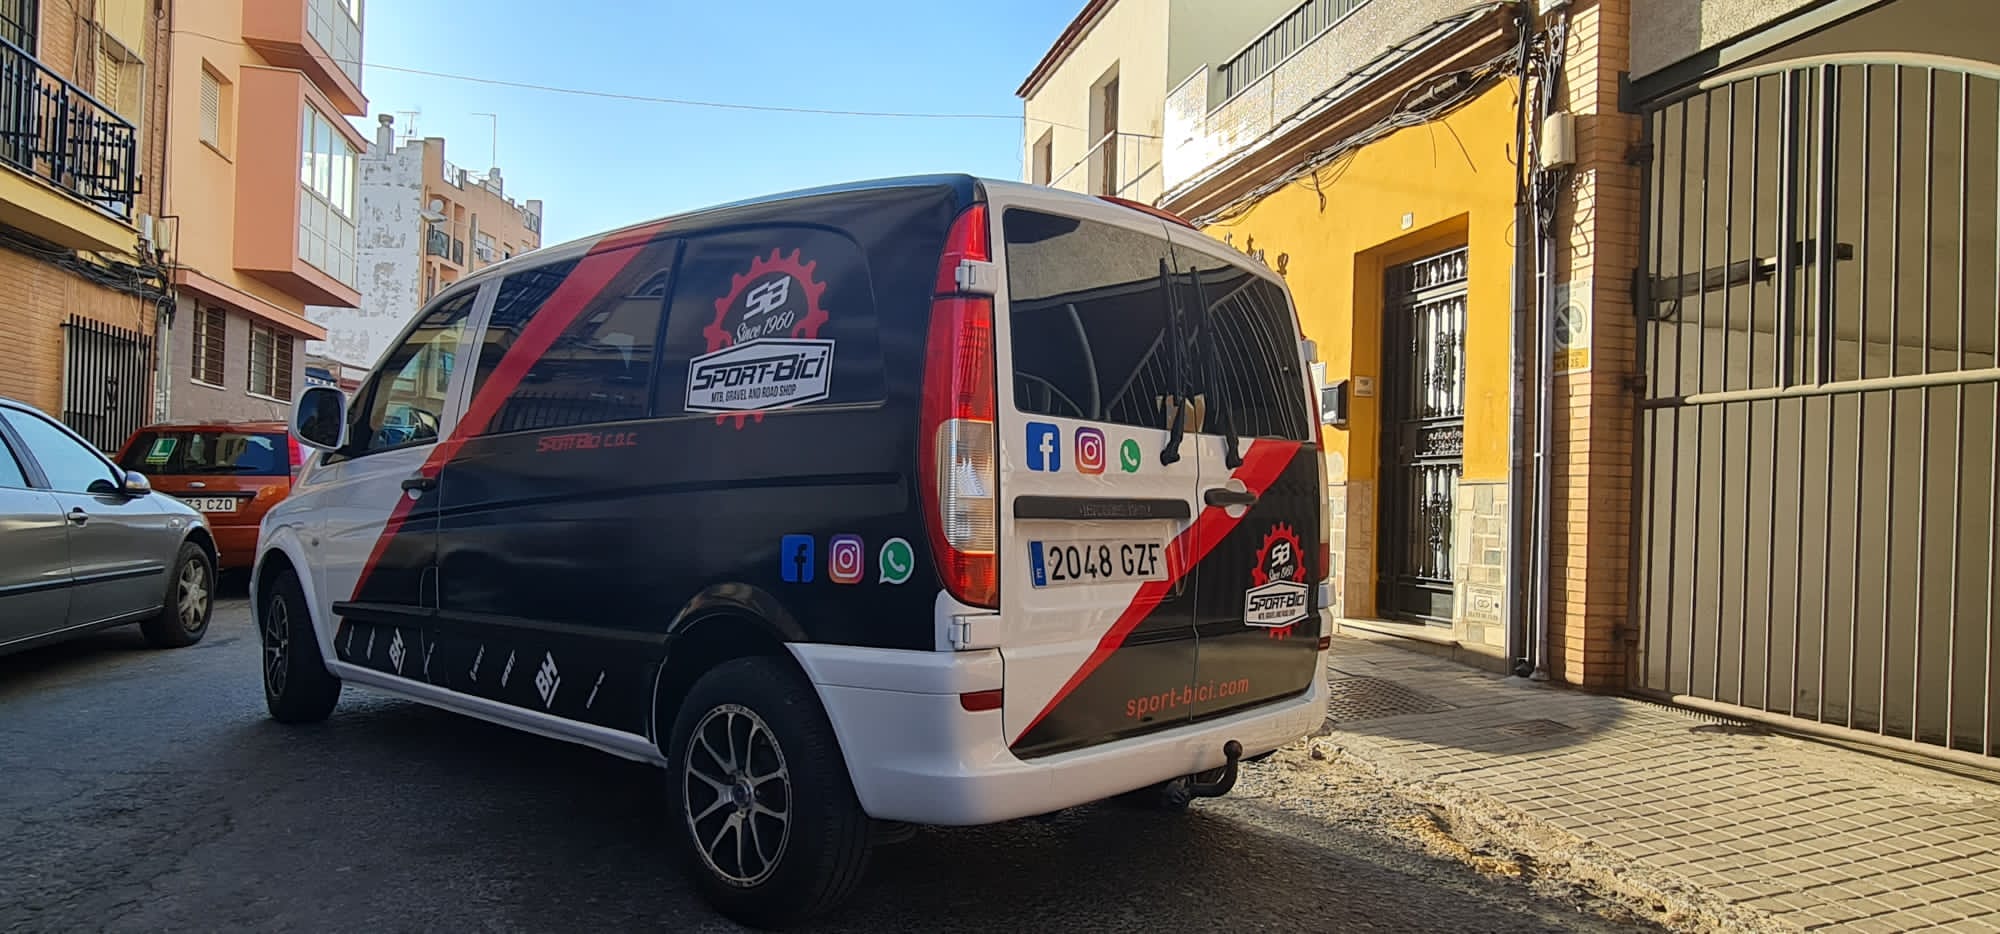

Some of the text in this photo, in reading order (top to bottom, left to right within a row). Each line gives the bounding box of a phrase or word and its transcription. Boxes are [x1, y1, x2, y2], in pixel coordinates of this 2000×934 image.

[743, 275, 791, 320] SB
[733, 310, 794, 345] Since 1960
[725, 389, 747, 402] GRAVEL
[748, 388, 761, 400] AND
[762, 386, 779, 398] ROAD
[779, 383, 797, 397] SHOP
[207, 499, 233, 510] CZD
[1049, 543, 1160, 580] 2048 GZF
[1271, 542, 1290, 568] SB
[535, 650, 559, 702] BH
[1126, 678, 1250, 721] sport-bici.com
